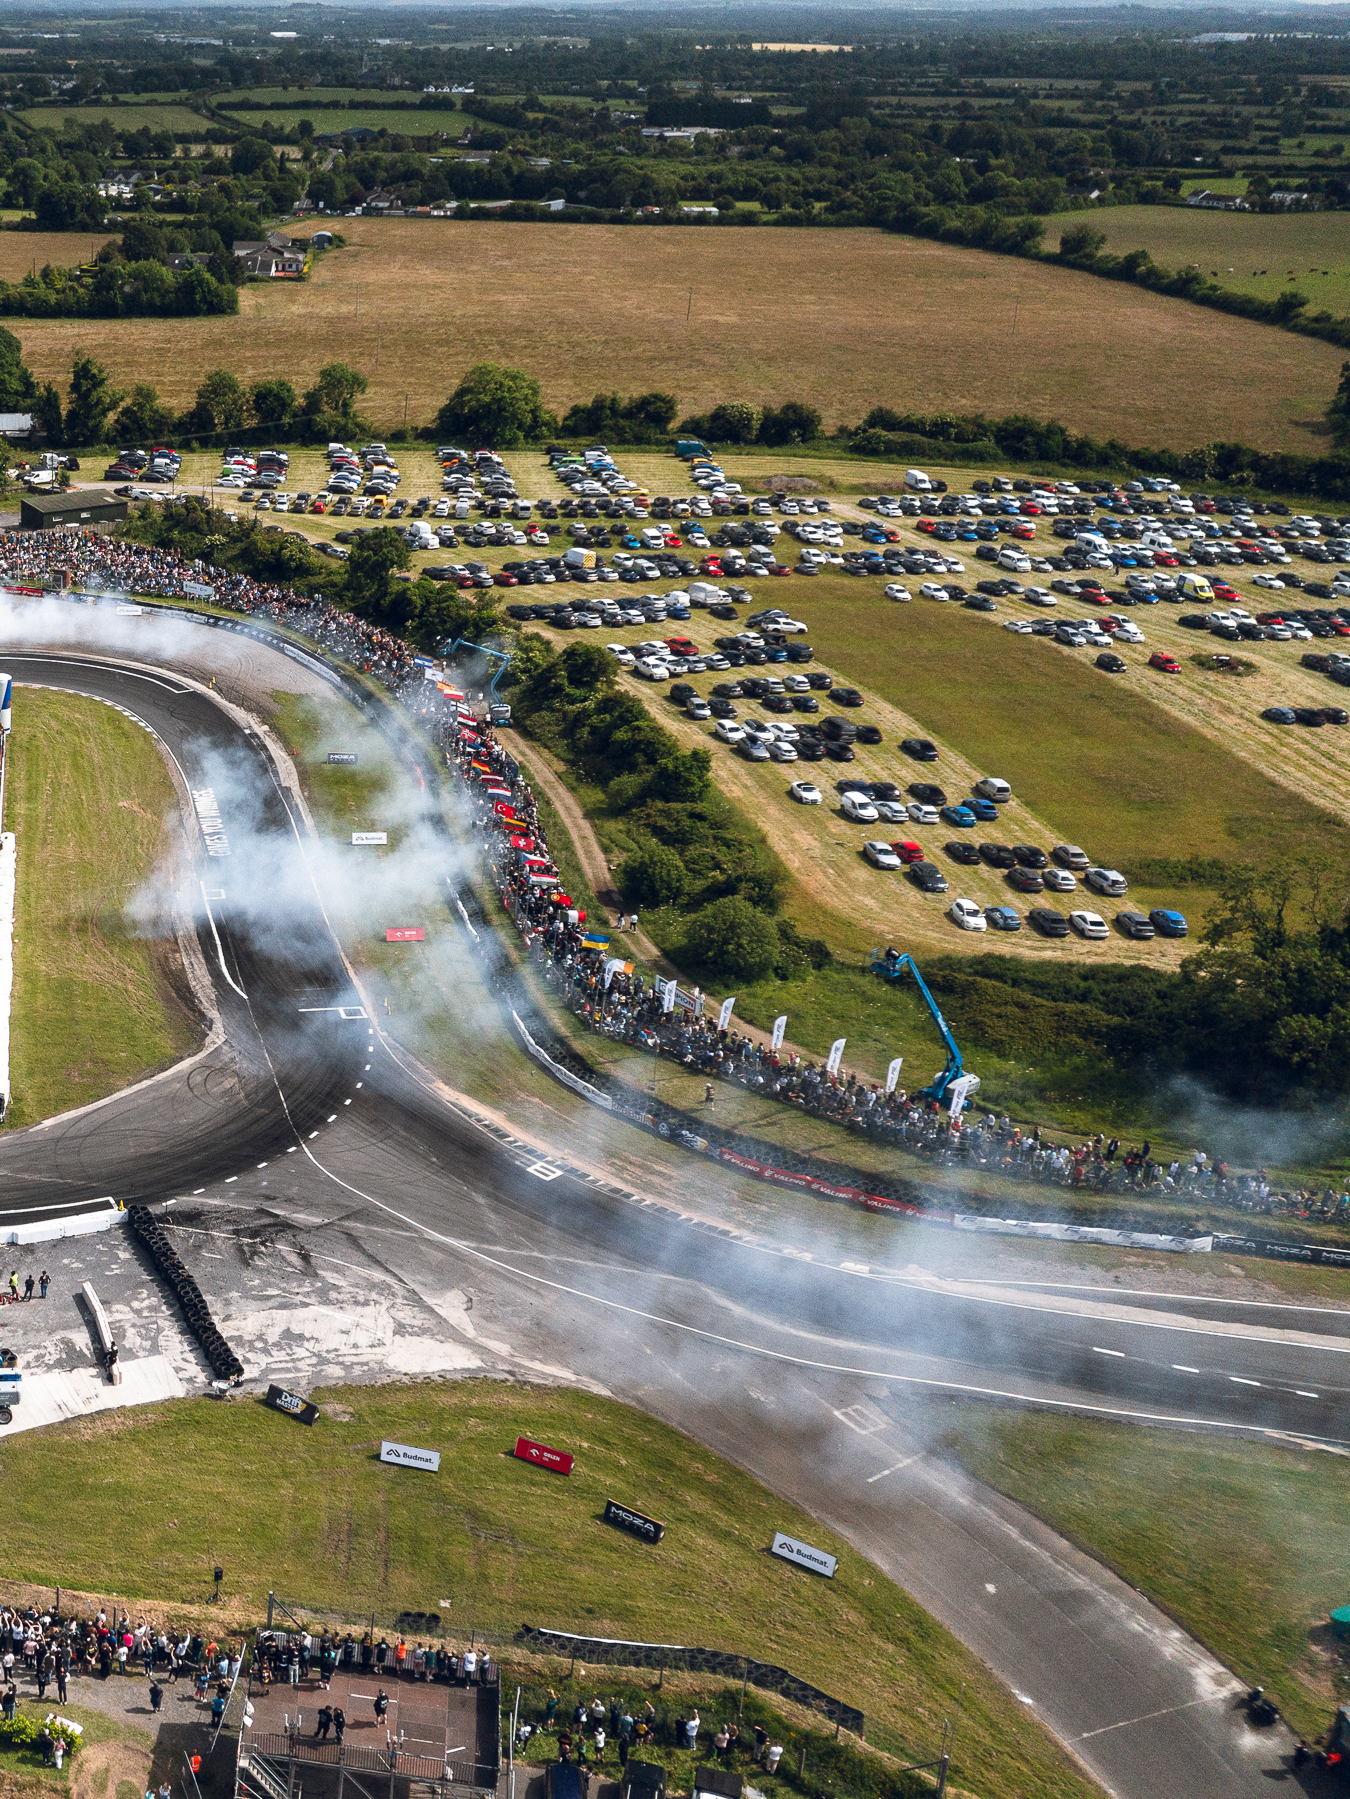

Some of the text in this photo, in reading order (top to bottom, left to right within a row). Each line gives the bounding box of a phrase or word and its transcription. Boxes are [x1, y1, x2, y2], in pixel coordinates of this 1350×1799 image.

[731, 1158, 760, 1172] VALINO
[774, 1172, 806, 1186] VALINO
[819, 1186, 853, 1199] VALINO
[867, 1199, 901, 1212] VALINO
[1214, 1238, 1256, 1248] MOZA
[1266, 1244, 1311, 1255] MOZA
[276, 1397, 301, 1414] MASTERS
[282, 1392, 303, 1409] Drift
[402, 1452, 434, 1464] Budmat.
[543, 1452, 561, 1462] ORLEN
[610, 1512, 654, 1537] RACING
[611, 1506, 655, 1532] MOZA
[796, 1548, 828, 1568] Budmat.
